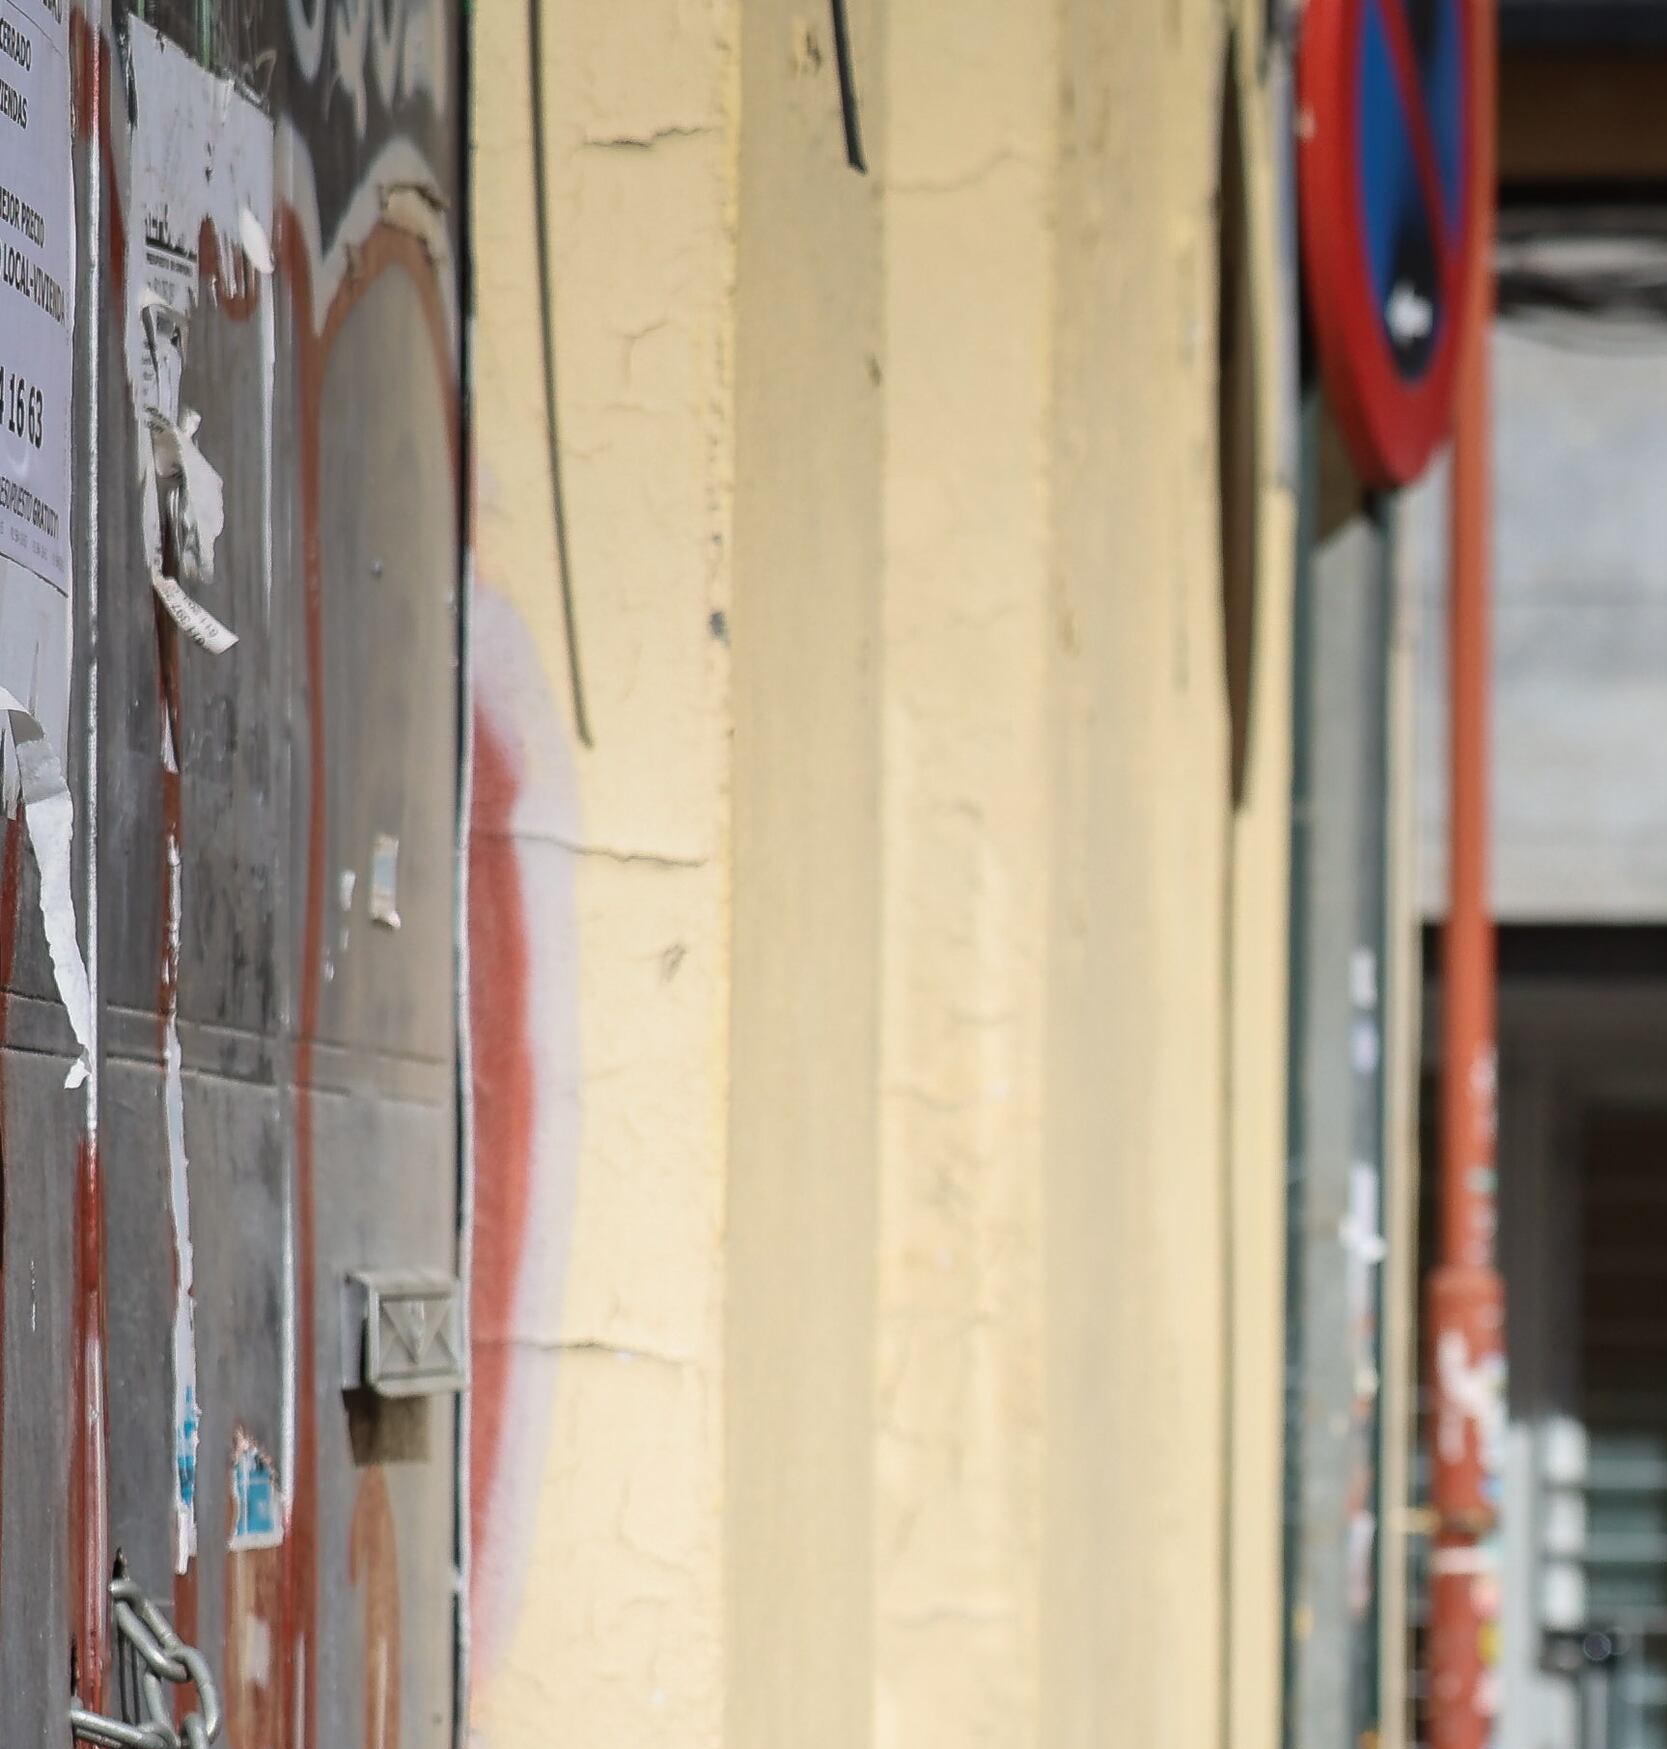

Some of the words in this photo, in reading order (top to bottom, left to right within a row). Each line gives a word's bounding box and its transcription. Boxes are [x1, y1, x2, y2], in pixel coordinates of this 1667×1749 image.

[21, 202, 45, 249] PRECIO
[8, 373, 25, 438] 16
[28, 386, 43, 449] 63
